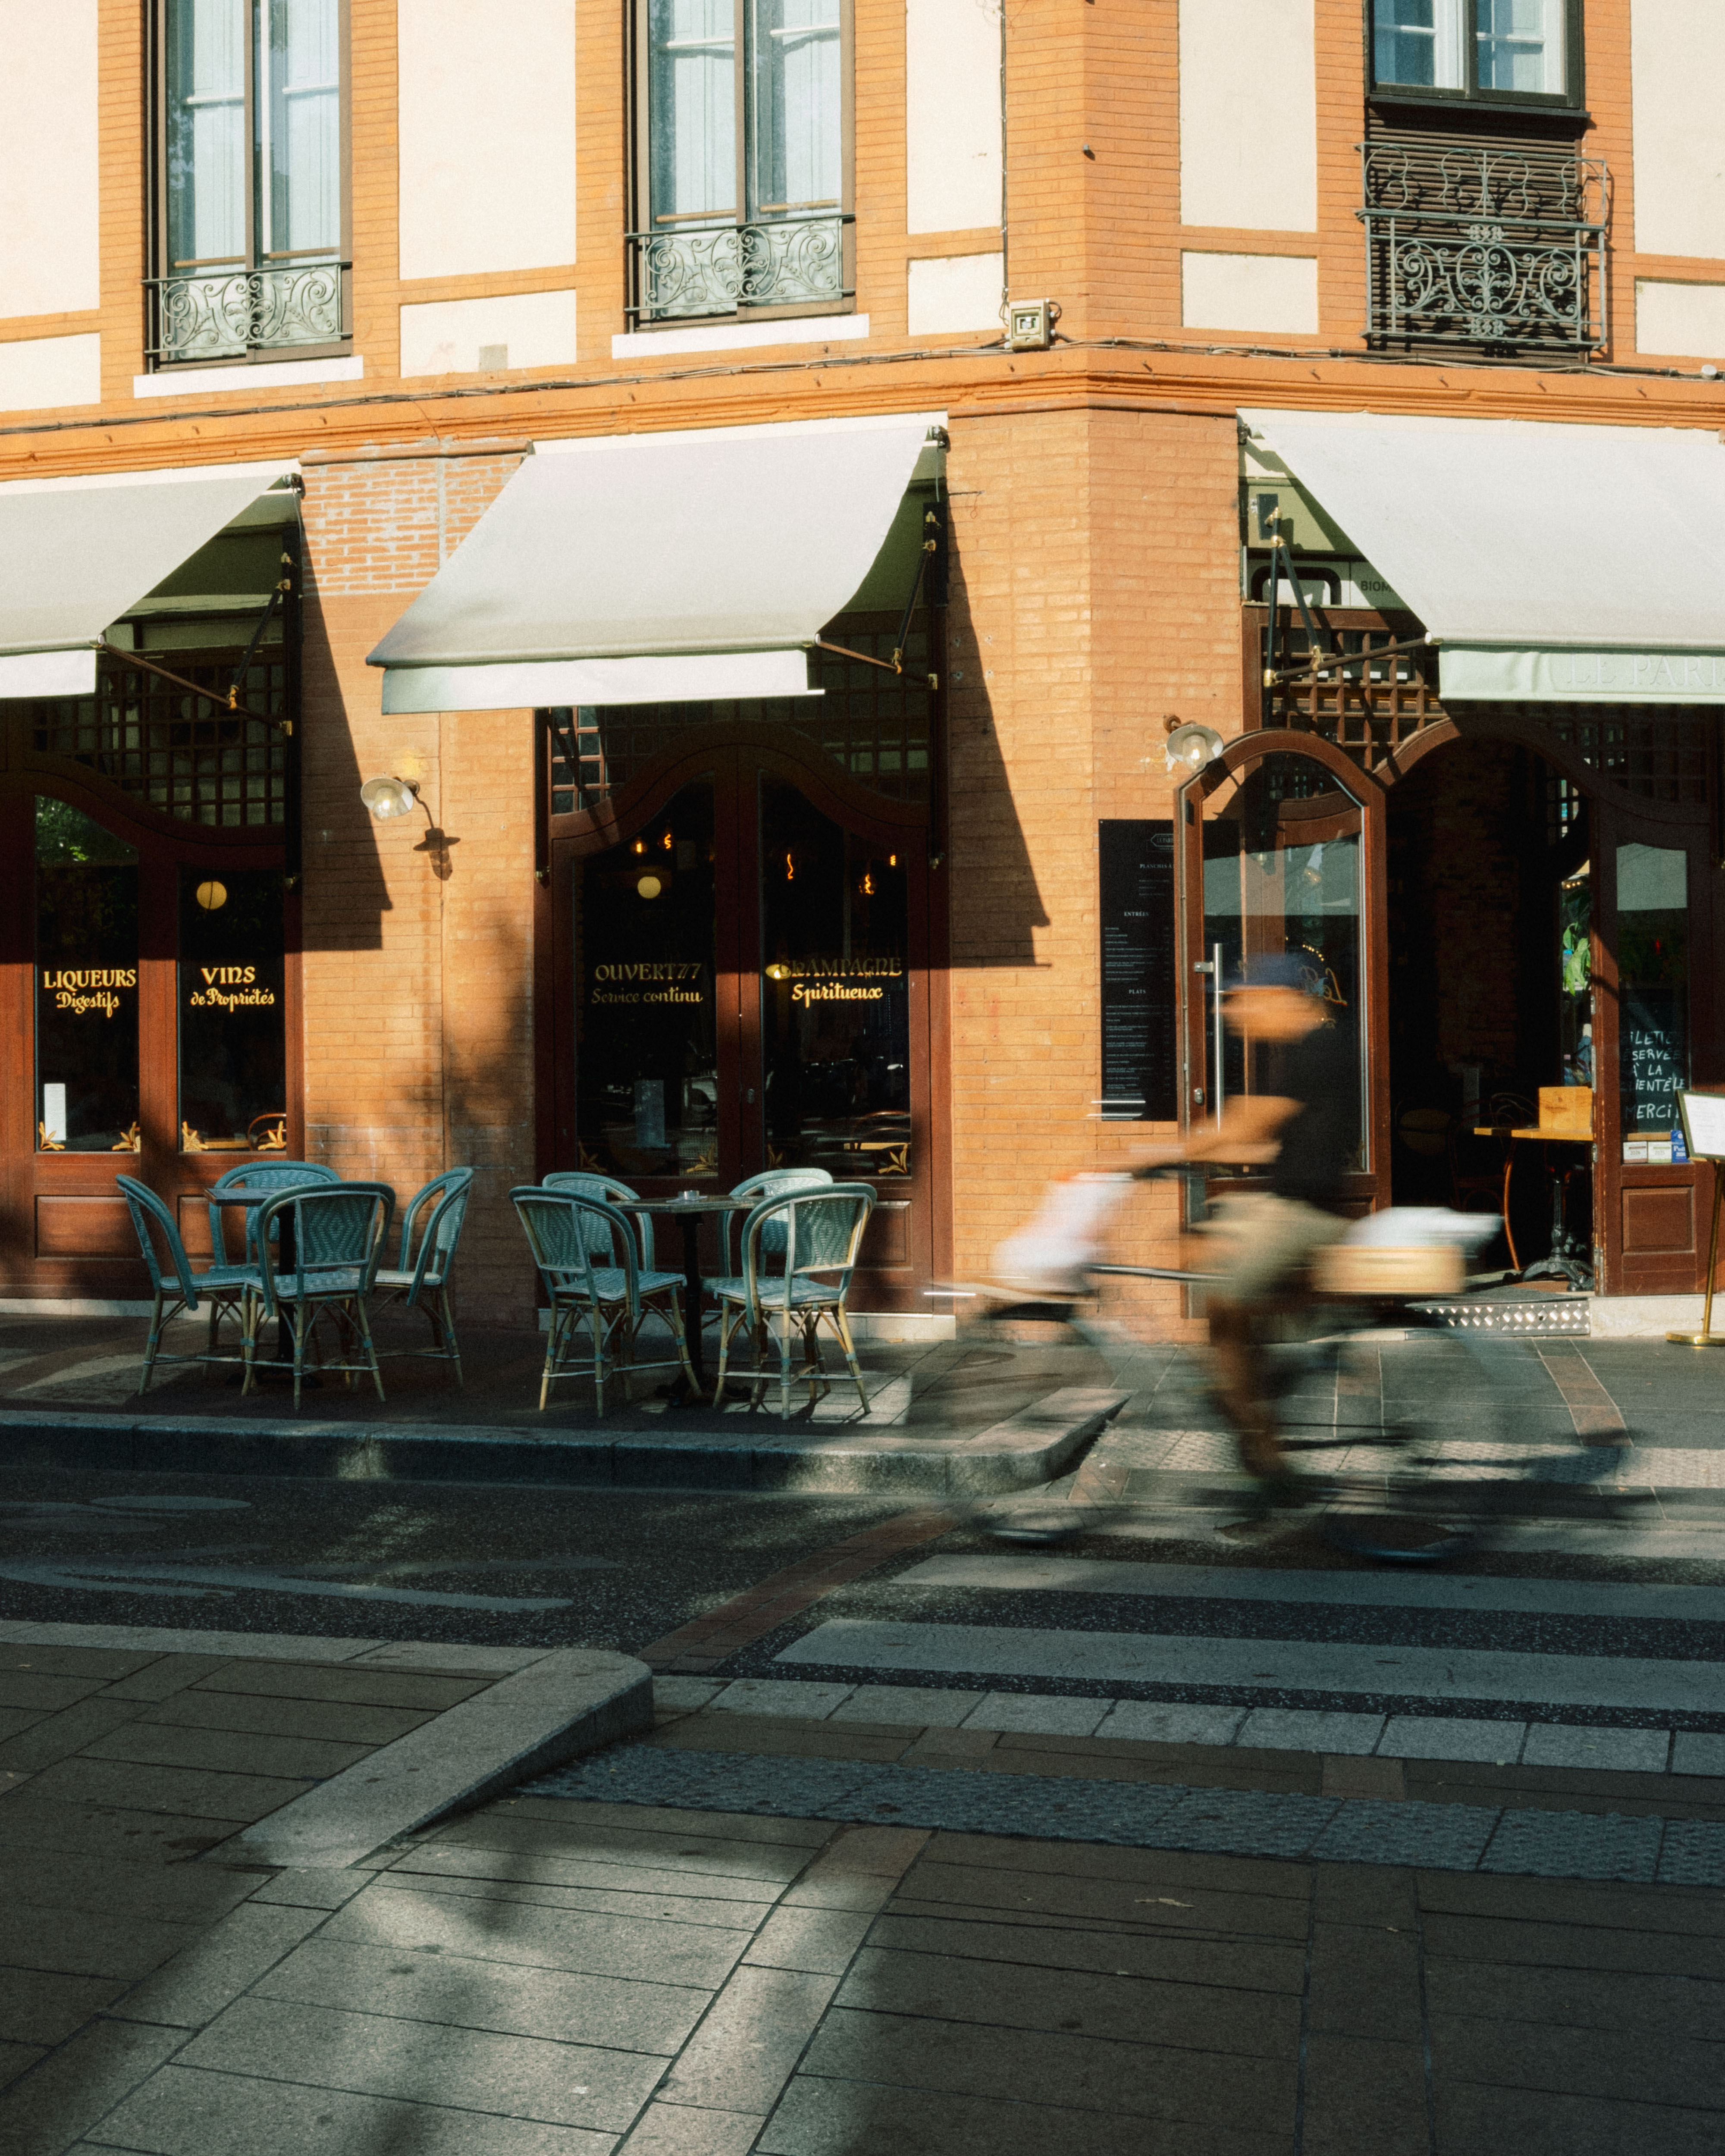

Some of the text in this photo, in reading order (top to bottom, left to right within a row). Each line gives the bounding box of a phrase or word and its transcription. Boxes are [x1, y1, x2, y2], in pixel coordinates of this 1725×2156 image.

[1361, 580, 1393, 592] BIOM
[1567, 654, 1725, 686] LE PARI
[44, 969, 137, 990] LIQUEURS
[201, 966, 255, 984] VINS
[595, 963, 676, 981] OUVERT
[56, 991, 120, 1018] Digestifs
[191, 987, 275, 1012] de Propriétés
[591, 986, 703, 1004] Service continu
[791, 981, 884, 1009] Spiritueux
[1648, 1063, 1663, 1076] LA
